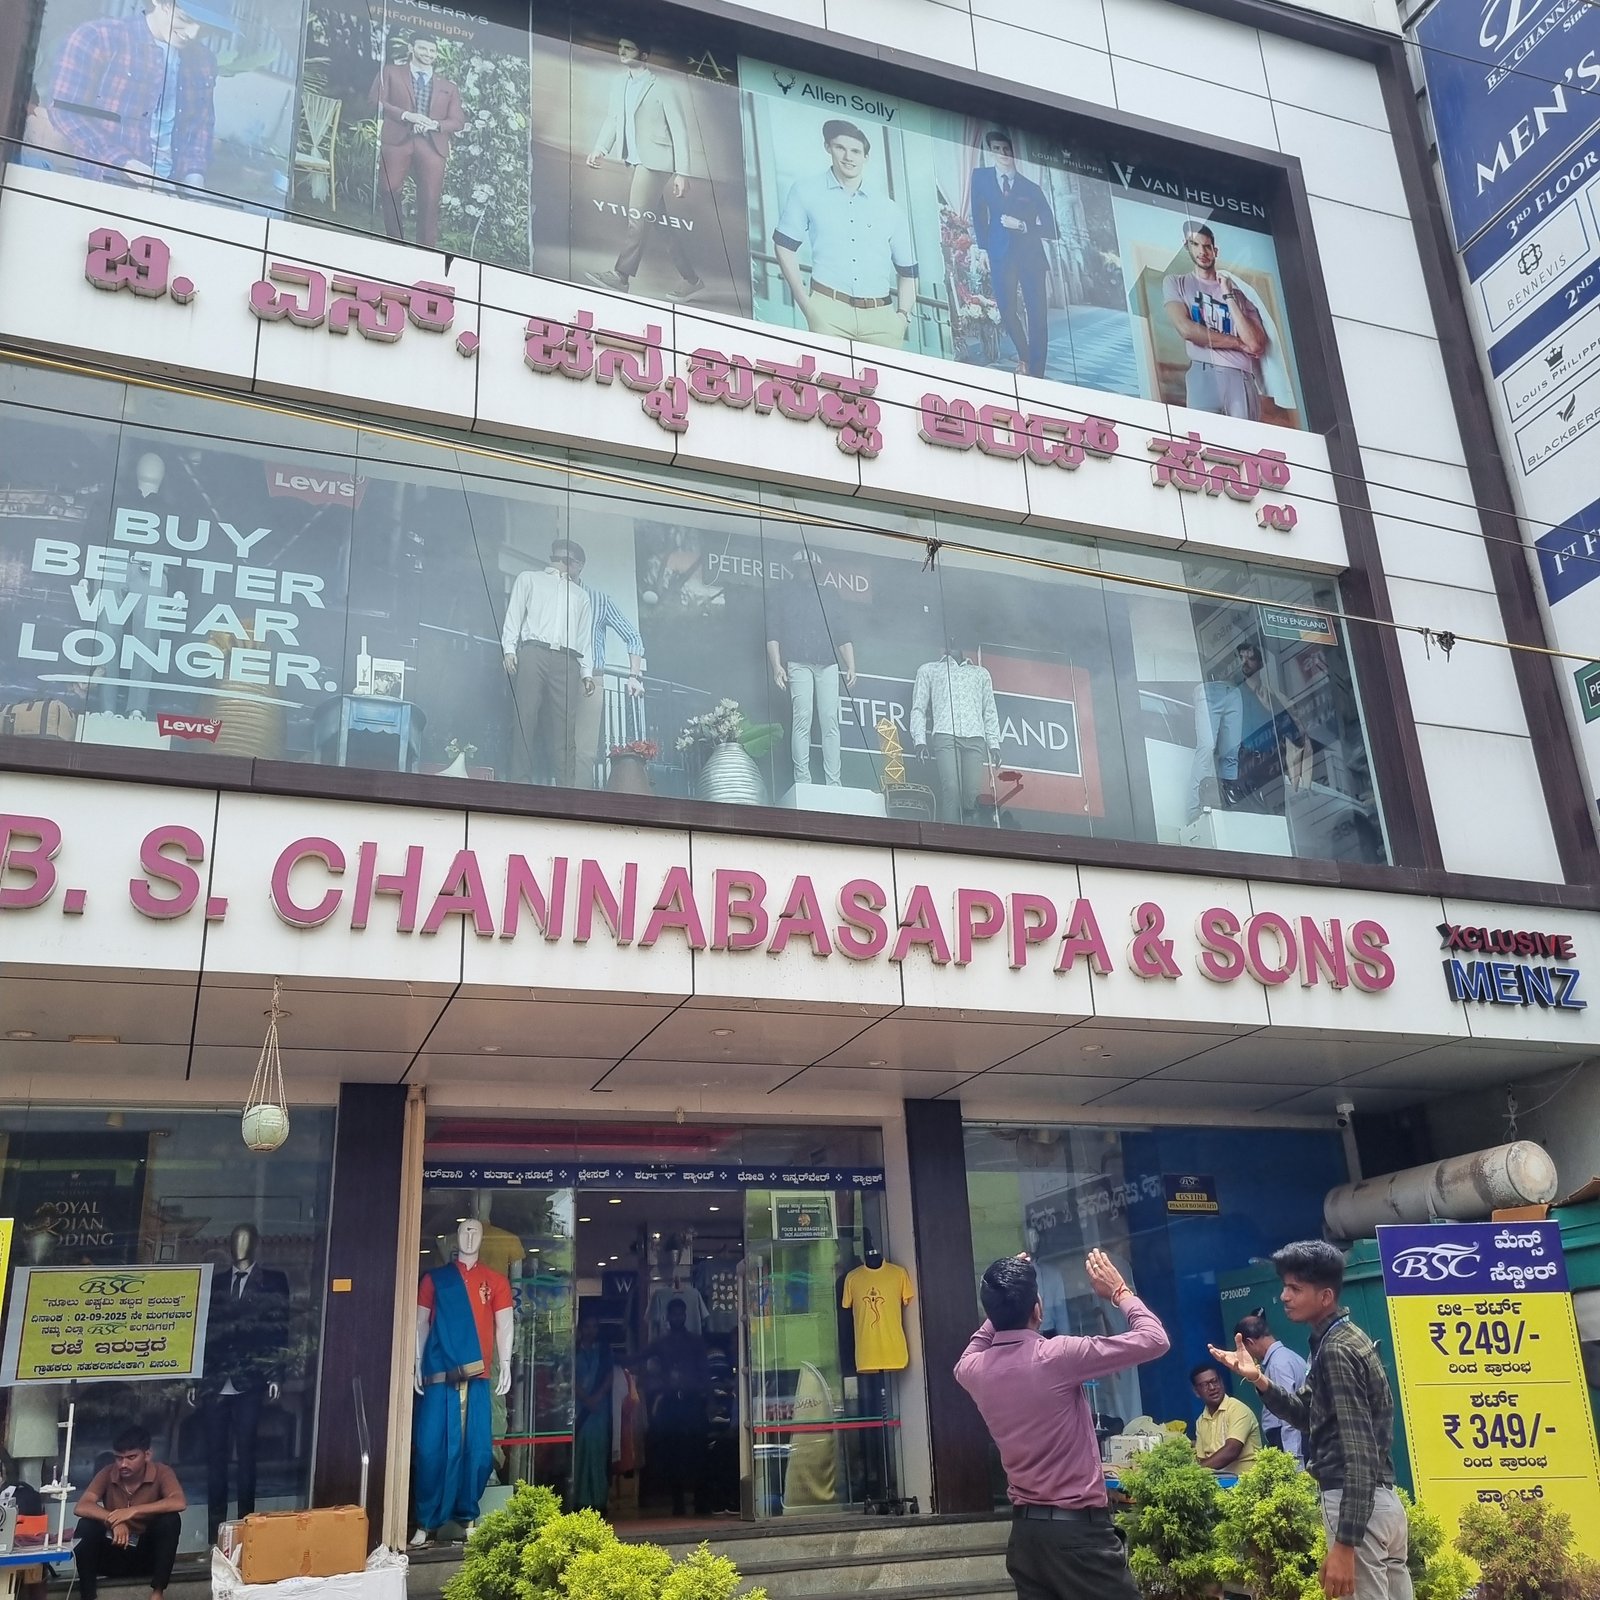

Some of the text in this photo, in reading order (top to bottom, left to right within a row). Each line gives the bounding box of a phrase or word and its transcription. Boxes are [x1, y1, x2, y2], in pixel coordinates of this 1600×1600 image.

[368, 5, 475, 40] #FitForTheBigDay
[801, 83, 897, 122] Allen Solly
[1140, 175, 1180, 197] VAN
[1185, 187, 1266, 219] HEUSEN
[1507, 151, 1599, 239] 3RD FLOOR
[1507, 254, 1567, 311] BENNEVIS
[1564, 274, 1594, 310] 2ND
[524, 310, 885, 459] ಚನ್ನಬಸಪ್ಪ
[1515, 380, 1549, 409] LOUIS
[113, 507, 273, 559] BUY
[31, 537, 327, 610] BETTER
[708, 553, 763, 578] PETER
[70, 584, 301, 647] WEAR
[1267, 613, 1328, 630] PETER ENGLAND
[17, 622, 339, 693] LONGER.
[0, 812, 1397, 993] B. S. CHANNABASAPPA & SONS
[1436, 923, 1577, 961] XCLUSIVE
[1442, 958, 1588, 1010] MENZ
[1392, 1242, 1481, 1282] BSC
[79, 1275, 146, 1296] BSC
[74, 1312, 127, 1322] 02-09-2025
[51, 1336, 167, 1358] ರಜೆ ಇರುತ್ತದೆ
